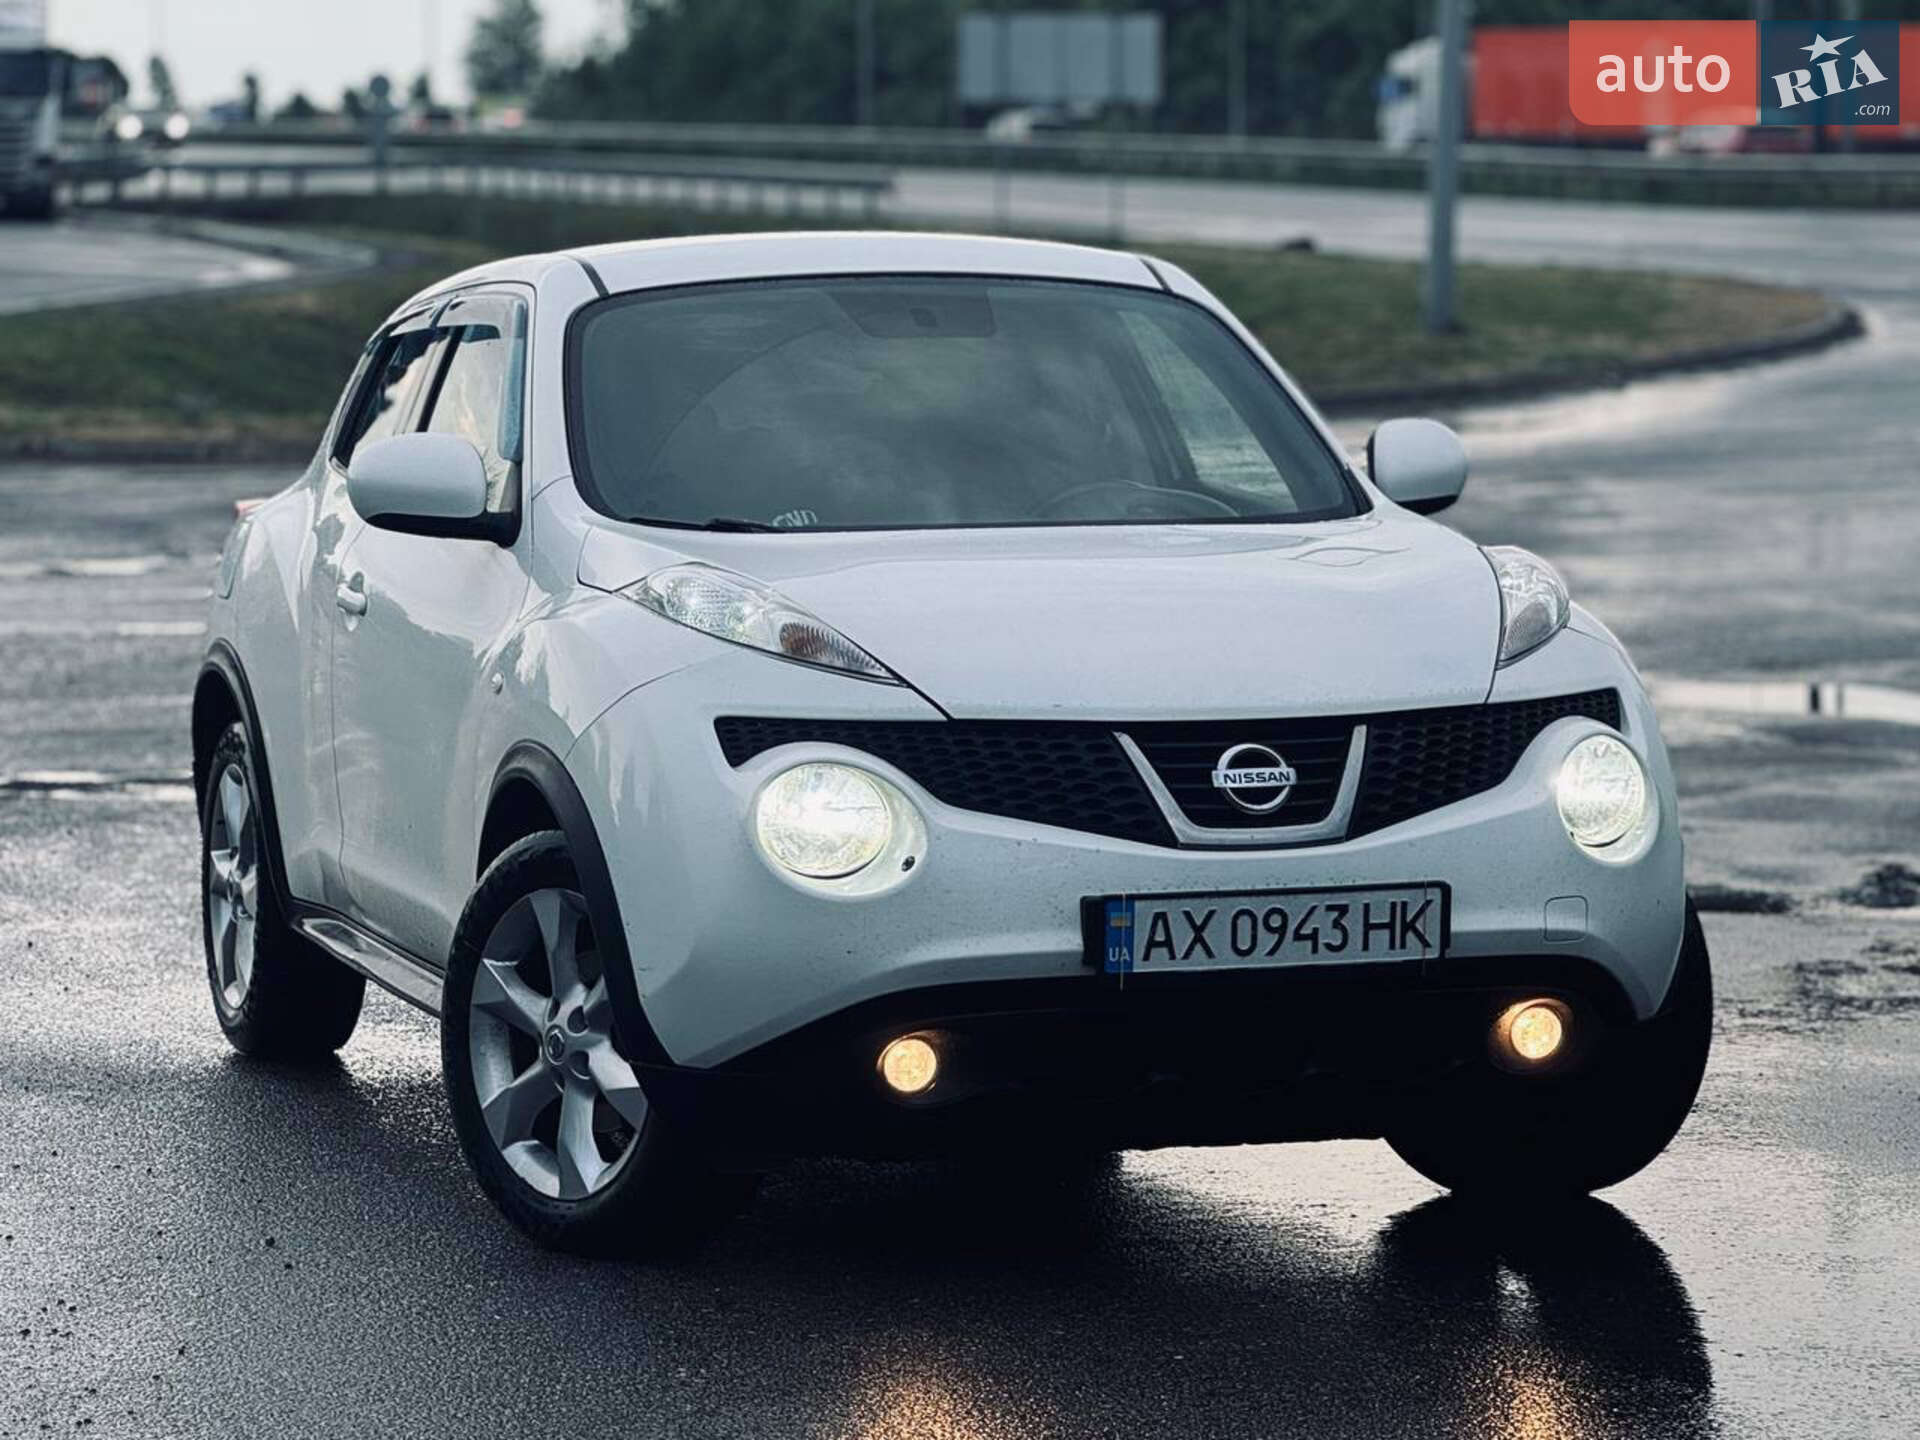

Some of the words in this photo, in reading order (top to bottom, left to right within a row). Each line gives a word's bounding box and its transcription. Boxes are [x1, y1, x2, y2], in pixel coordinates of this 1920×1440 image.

[1223, 770, 1291, 785] NISSAN
[1141, 907, 1216, 962] AX
[1230, 903, 1350, 957] 0943
[1360, 898, 1434, 952] HK
[1108, 947, 1131, 962] UA
